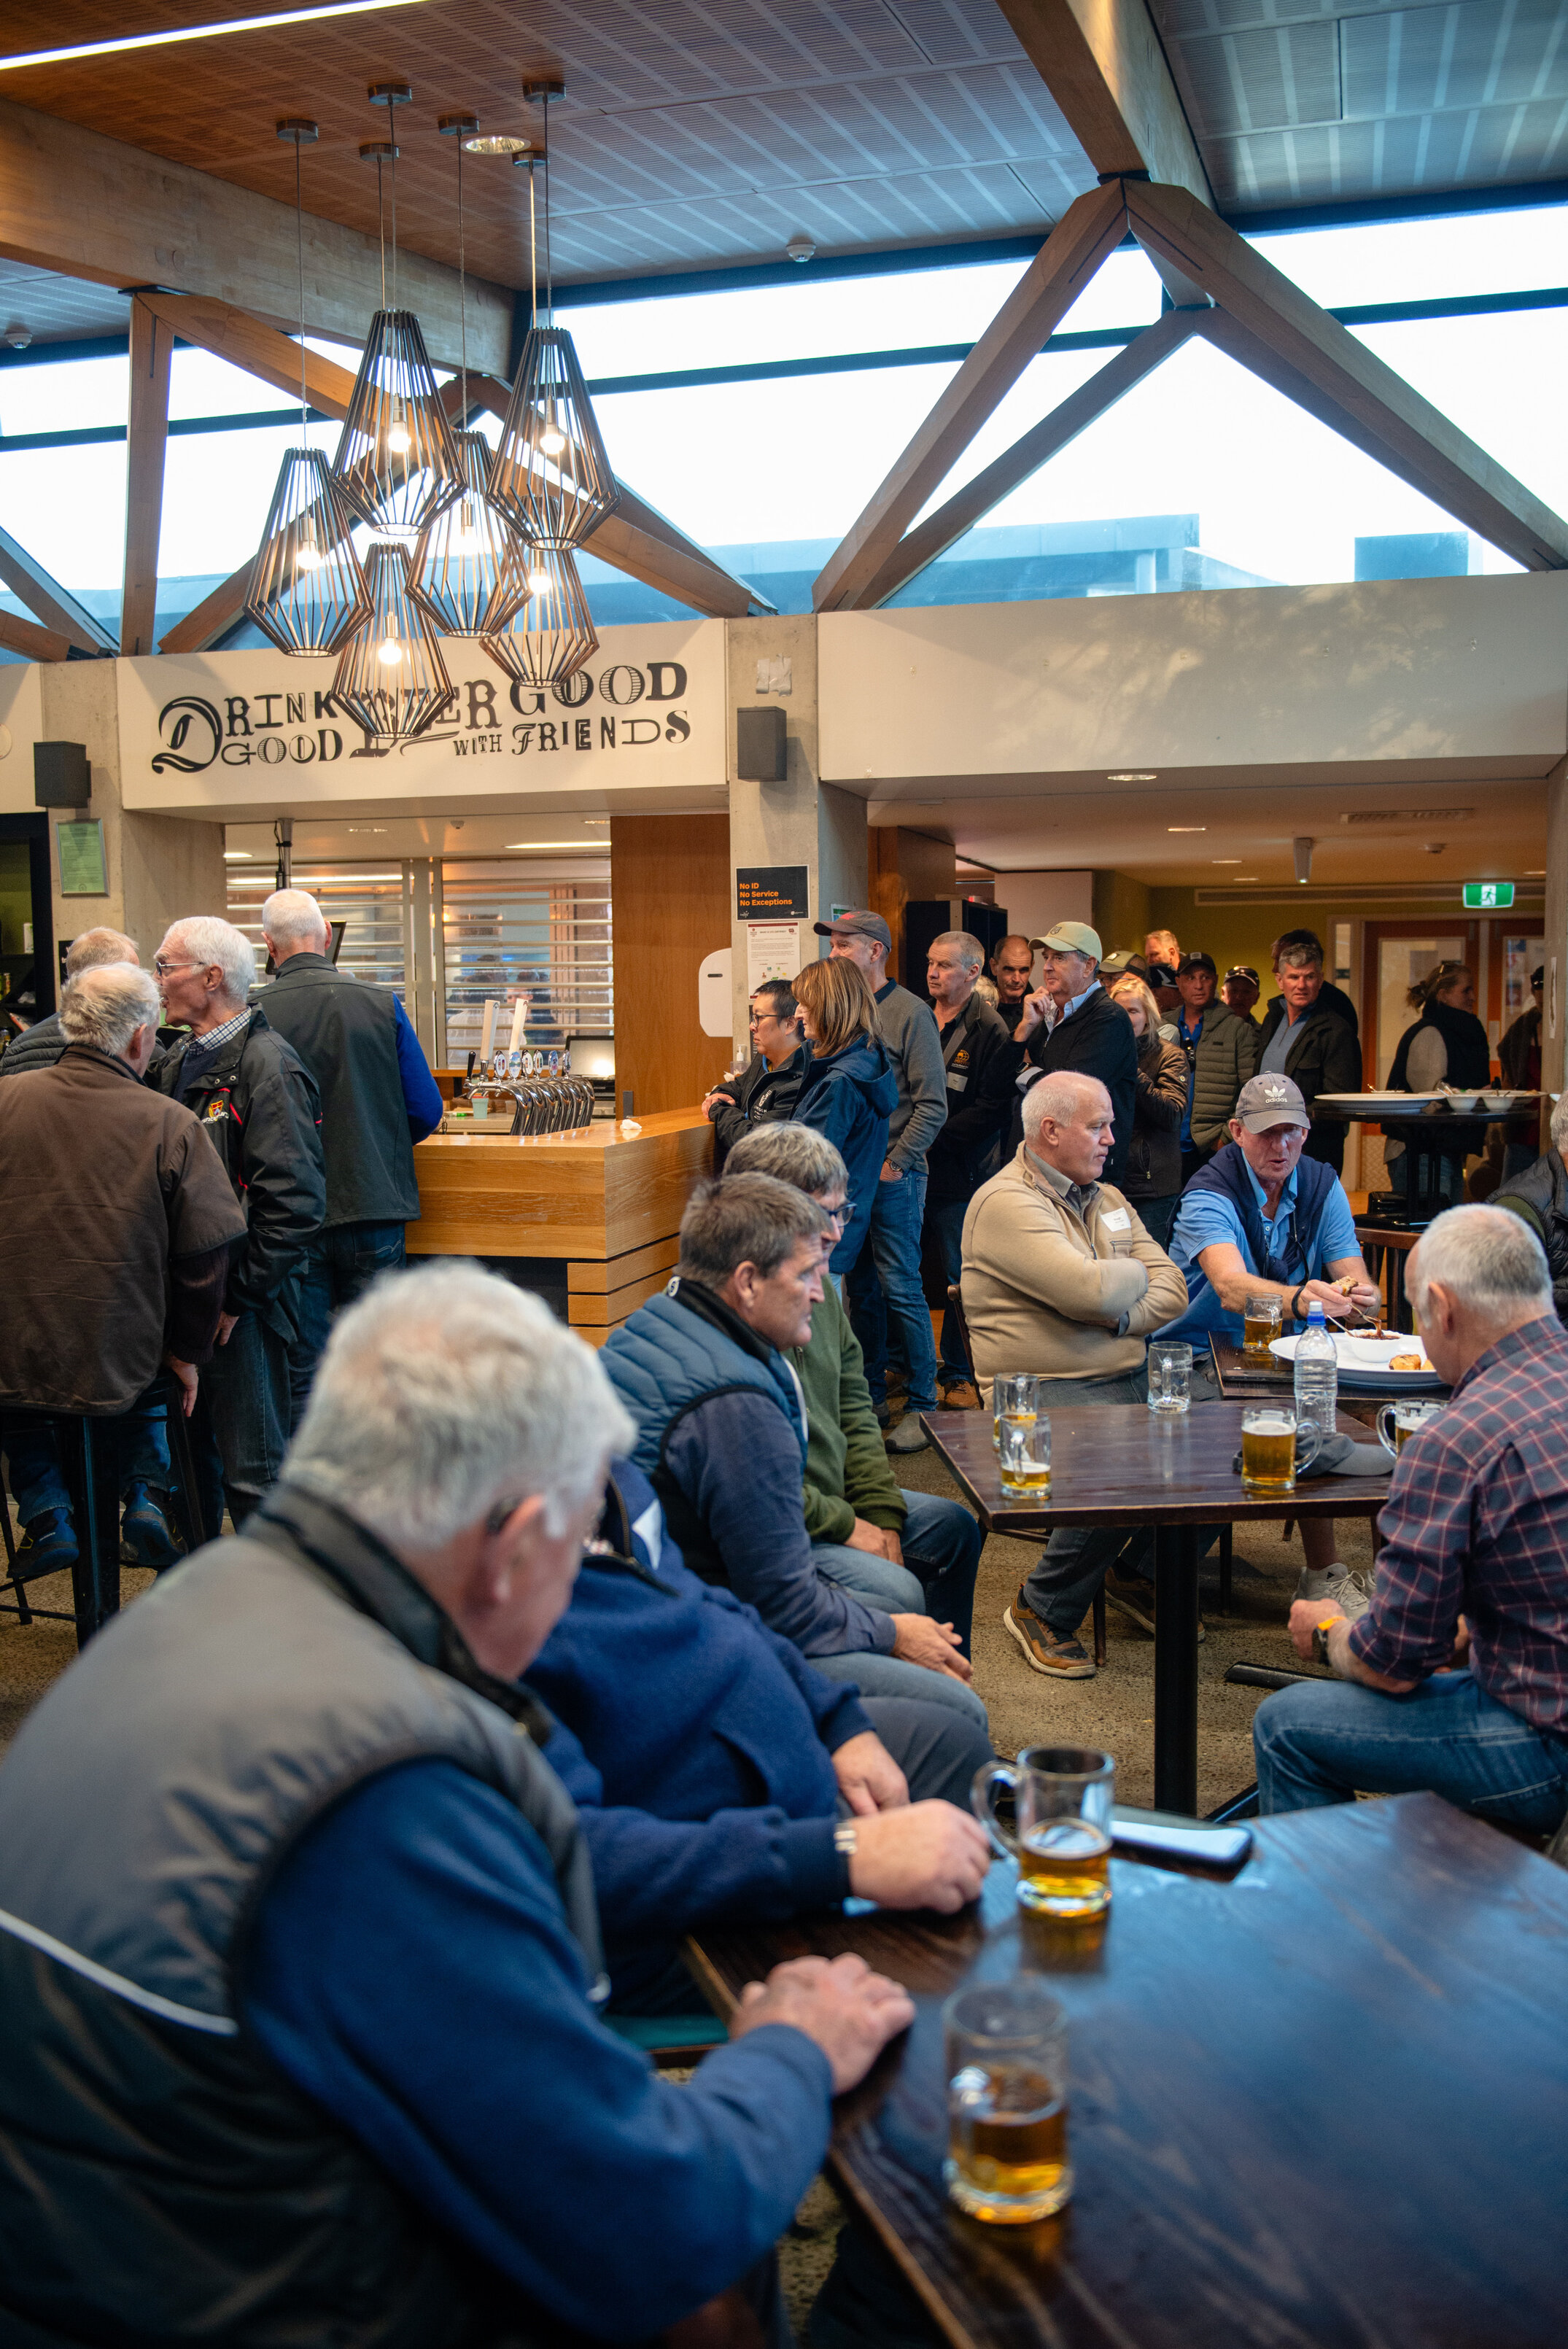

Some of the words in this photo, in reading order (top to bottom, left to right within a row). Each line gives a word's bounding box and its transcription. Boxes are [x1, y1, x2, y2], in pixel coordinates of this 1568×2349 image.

[152, 690, 338, 774] DRINK
[510, 661, 688, 715] GOOD
[221, 729, 343, 766] GOOD
[453, 734, 502, 756] WITH
[511, 710, 691, 756] FRIENDS
[751, 898, 793, 906] Exceptions
